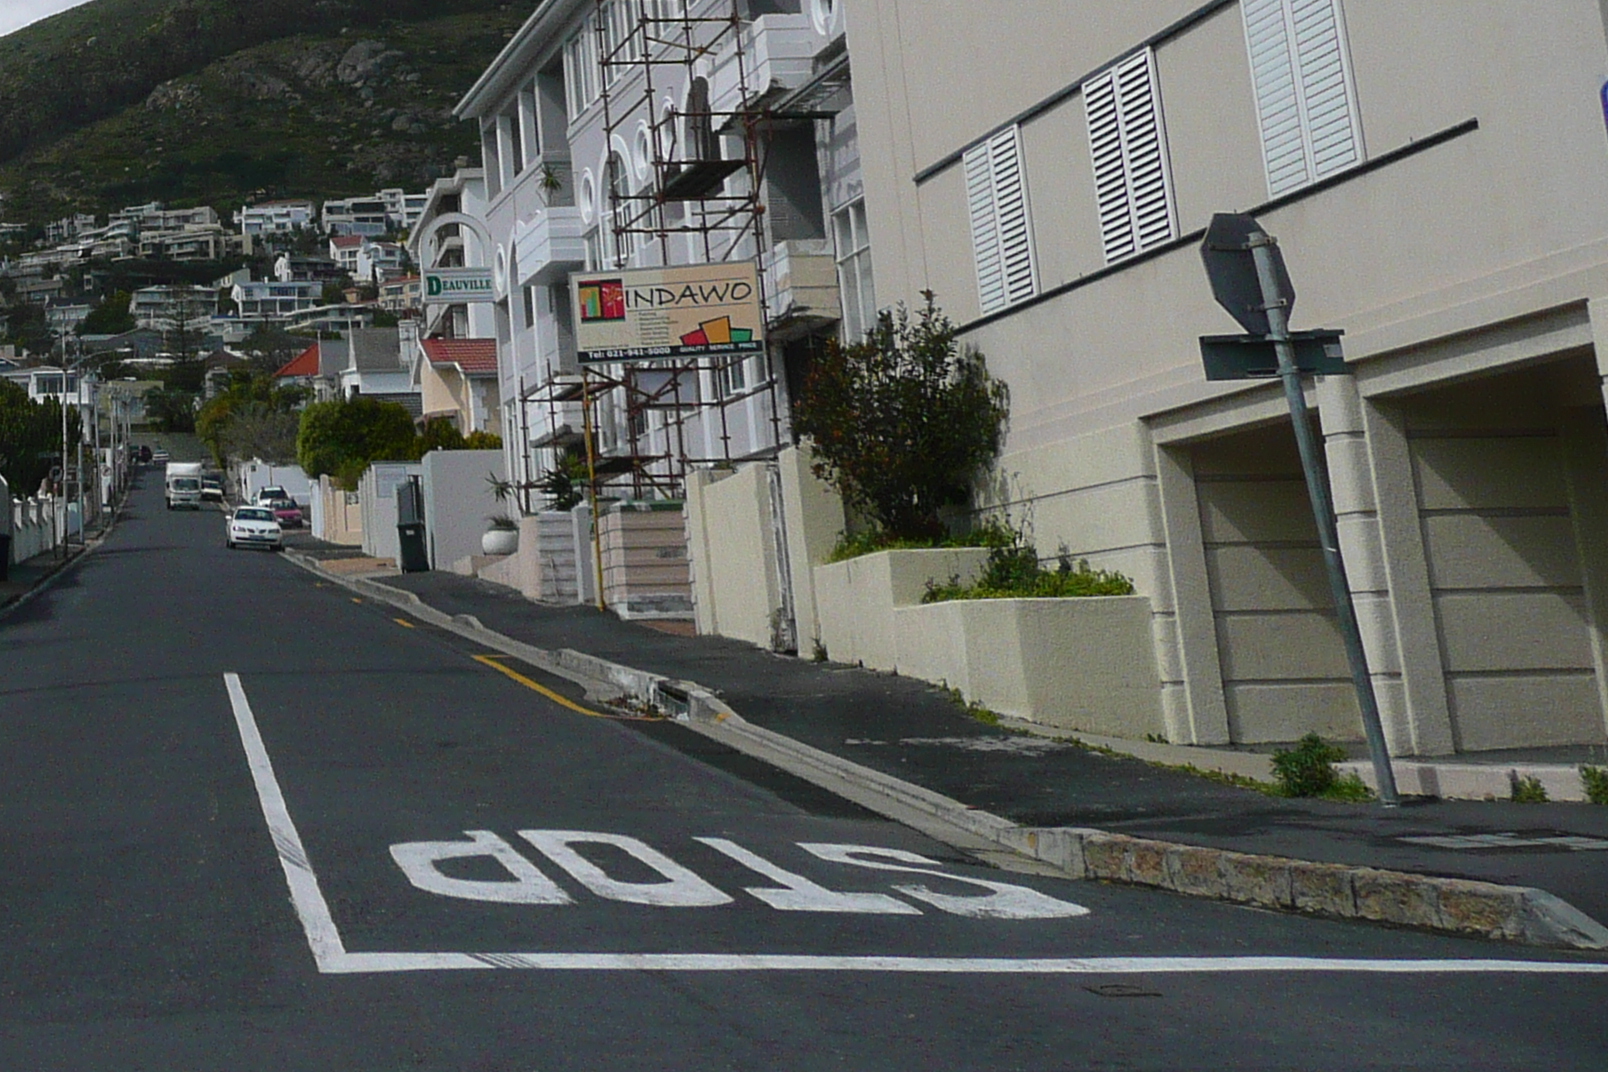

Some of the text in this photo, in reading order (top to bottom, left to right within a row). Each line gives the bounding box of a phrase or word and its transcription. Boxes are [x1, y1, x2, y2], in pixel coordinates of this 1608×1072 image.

[426, 275, 492, 296] DEAUVILLE
[625, 282, 752, 308] INDAWO
[388, 829, 1092, 919] STOP
